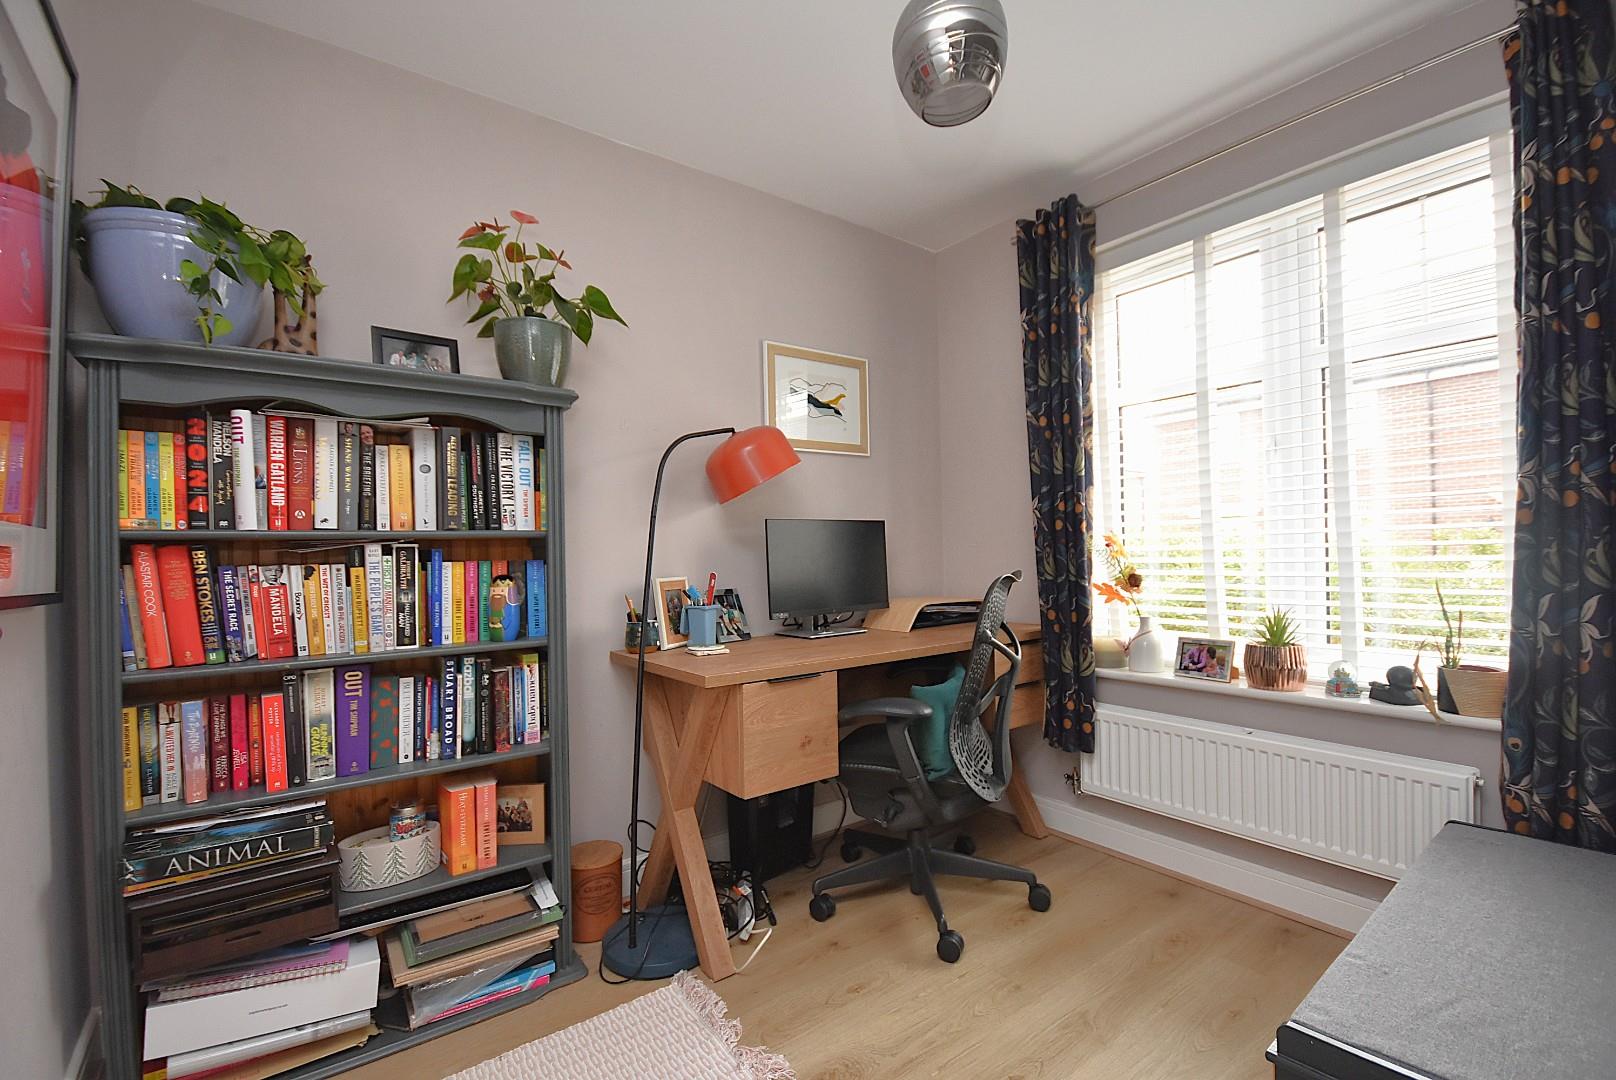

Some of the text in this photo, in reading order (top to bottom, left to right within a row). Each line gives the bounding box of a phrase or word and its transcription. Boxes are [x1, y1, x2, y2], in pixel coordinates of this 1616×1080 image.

[213, 420, 224, 464] MANDELA
[222, 421, 233, 457] NELSON
[234, 460, 242, 487] SHIPMAN
[269, 419, 286, 506] WARREN GATLAND
[344, 437, 353, 493] SHANE WARNE
[361, 451, 372, 497] THE BRIEFING
[499, 446, 515, 501] THE VICTORY
[518, 440, 532, 489] FALL OUT
[447, 478, 458, 517] LEADING
[138, 550, 158, 618] ALASTAIR COOK
[335, 572, 343, 591] ELEVEN
[368, 560, 381, 575] THE
[384, 564, 392, 580] FIRST
[399, 550, 408, 589] GALBRAITH
[191, 550, 216, 624] BEN STOKES
[223, 569, 239, 632] THE SECRET RACE
[294, 592, 303, 615] Bounce
[354, 574, 362, 600] WARREN
[369, 577, 383, 612] PEOPLE'S
[384, 591, 392, 616] MANUAL
[268, 588, 284, 636] MANDELA
[323, 597, 331, 619] CRICKET
[355, 600, 364, 627] BUFFETT
[404, 603, 412, 637] HALLMARKED
[338, 622, 346, 644] JACKSON
[371, 614, 384, 637] GAME
[344, 671, 363, 697] OUT
[463, 657, 476, 699] Bazball
[445, 660, 455, 744] STUART BROAD
[319, 723, 329, 756] RUNNING
[349, 711, 359, 737] SHIPMAN
[165, 729, 176, 754] INVITED
[310, 726, 321, 757] GRAVE
[166, 753, 177, 764] HER
[220, 755, 228, 779] REBECCA
[232, 748, 241, 771] JEWELL
[164, 835, 290, 877] ANIMAL
